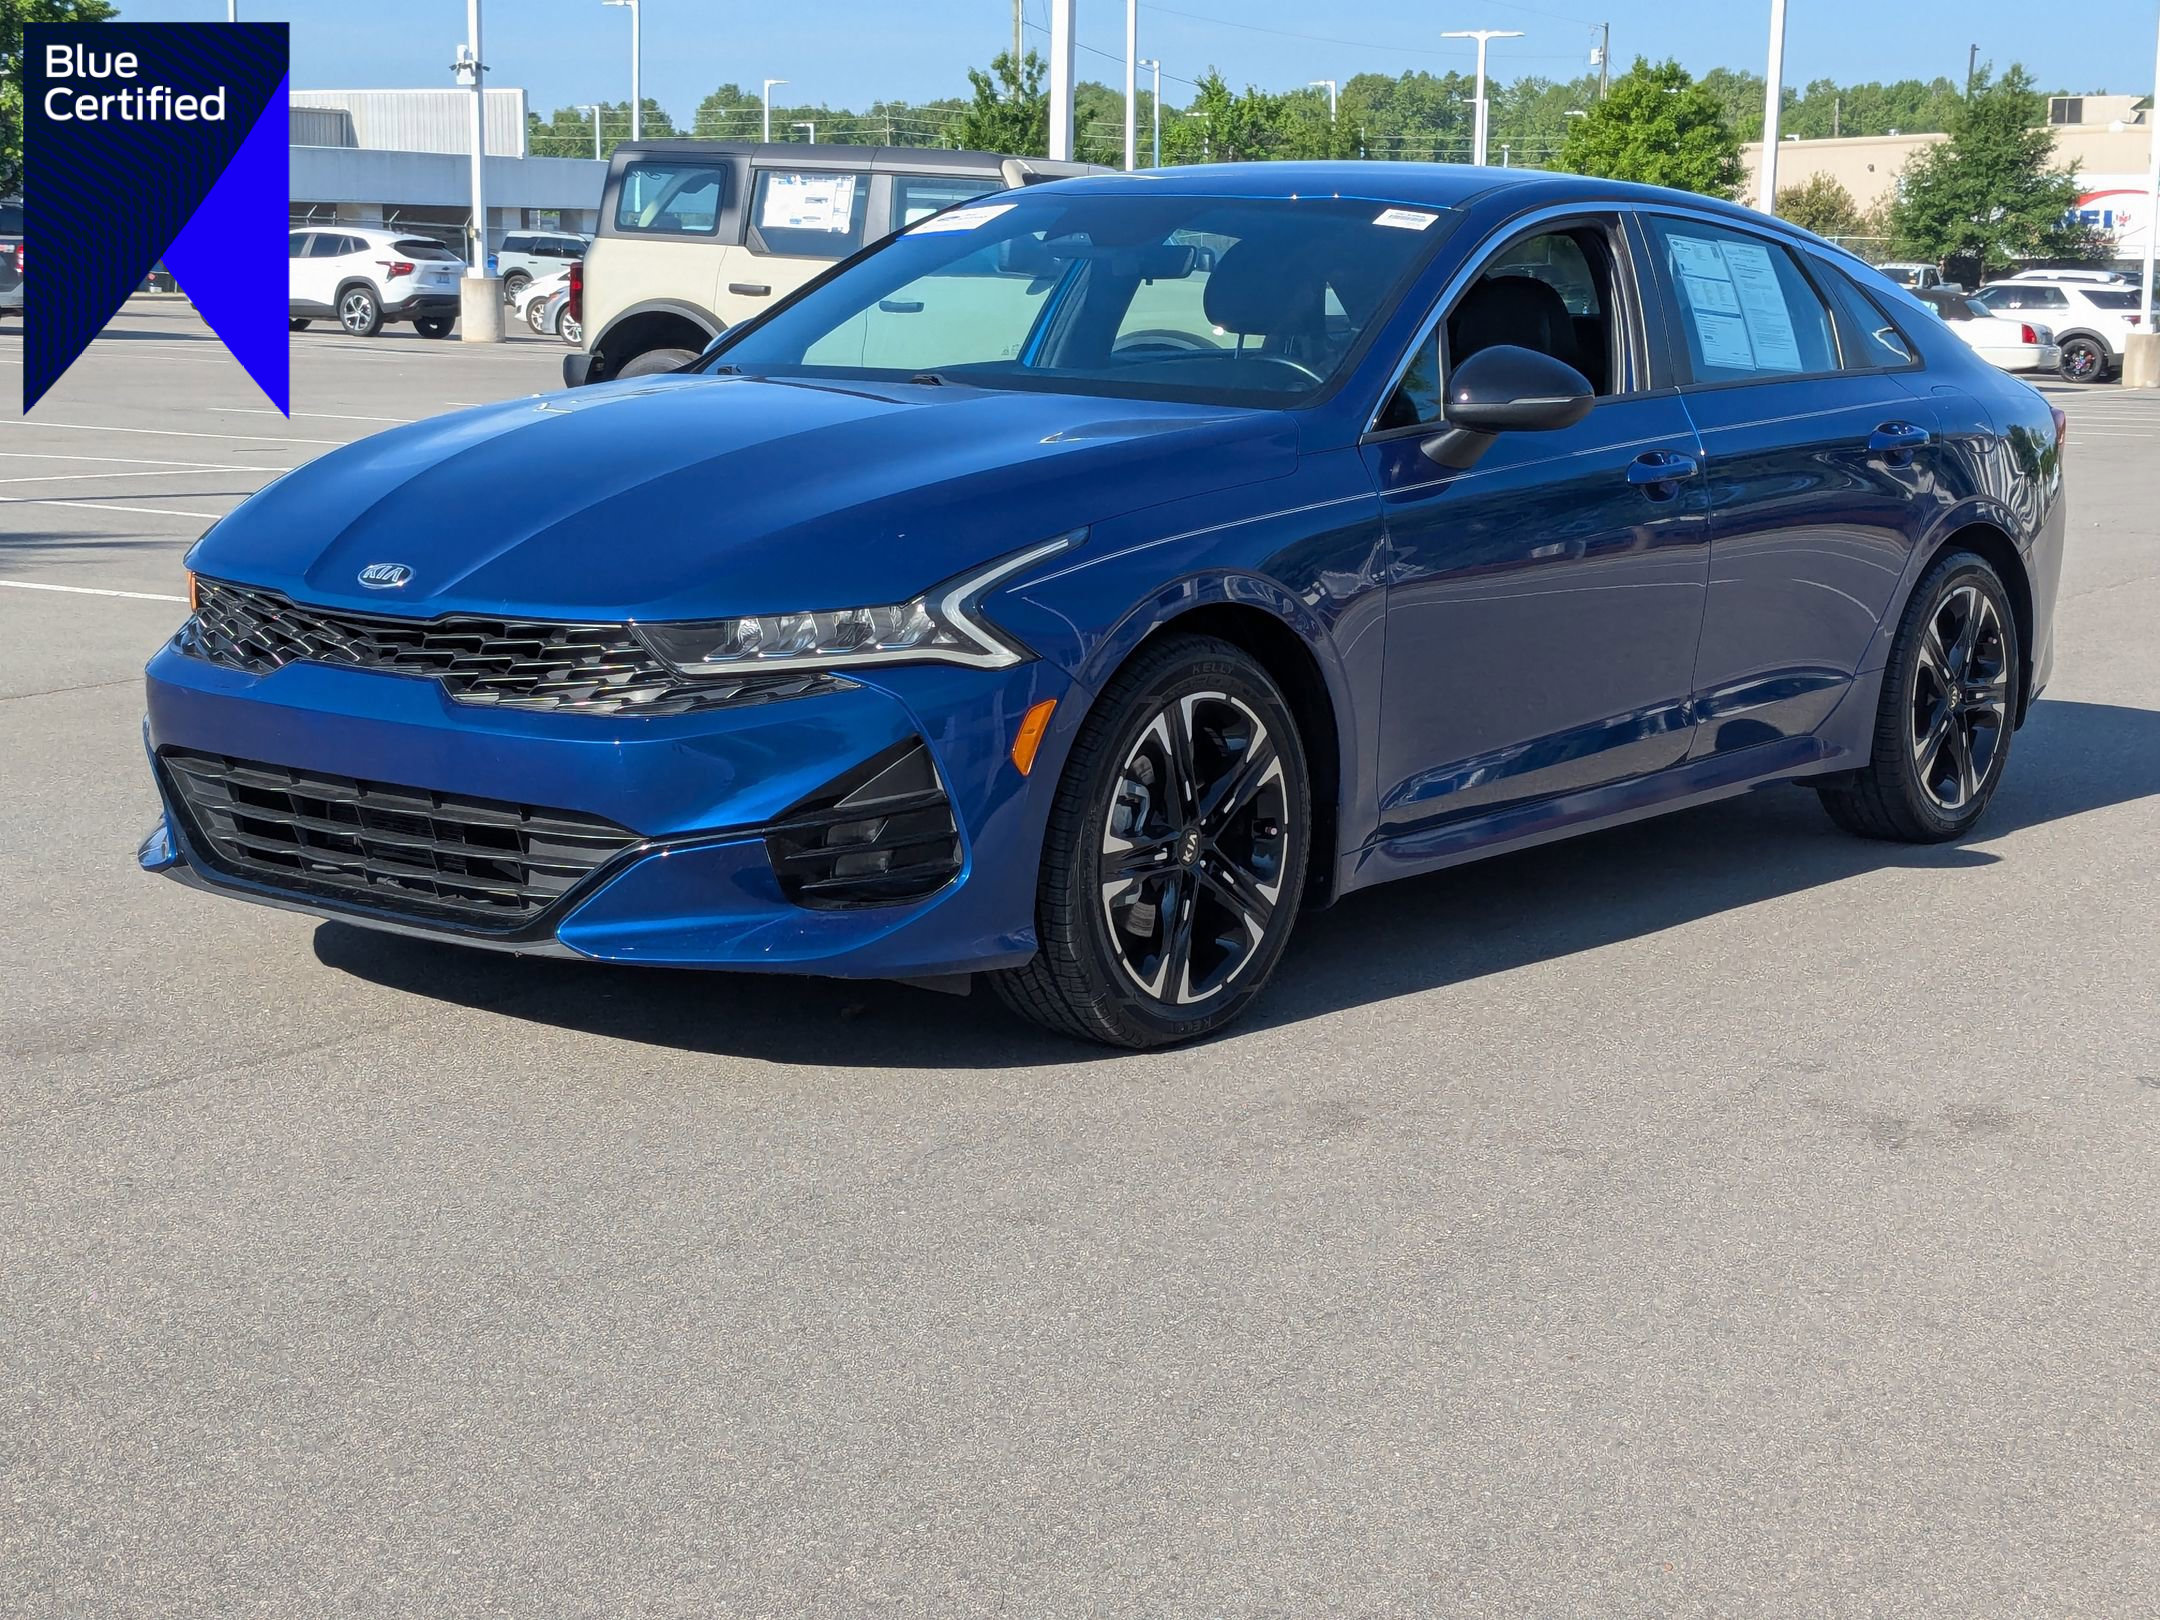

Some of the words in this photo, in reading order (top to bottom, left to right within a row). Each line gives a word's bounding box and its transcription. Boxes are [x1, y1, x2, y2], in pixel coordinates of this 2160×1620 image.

[363, 565, 404, 582] KIA
[1192, 661, 1234, 675] KELLY
[1182, 834, 1197, 862] KIA
